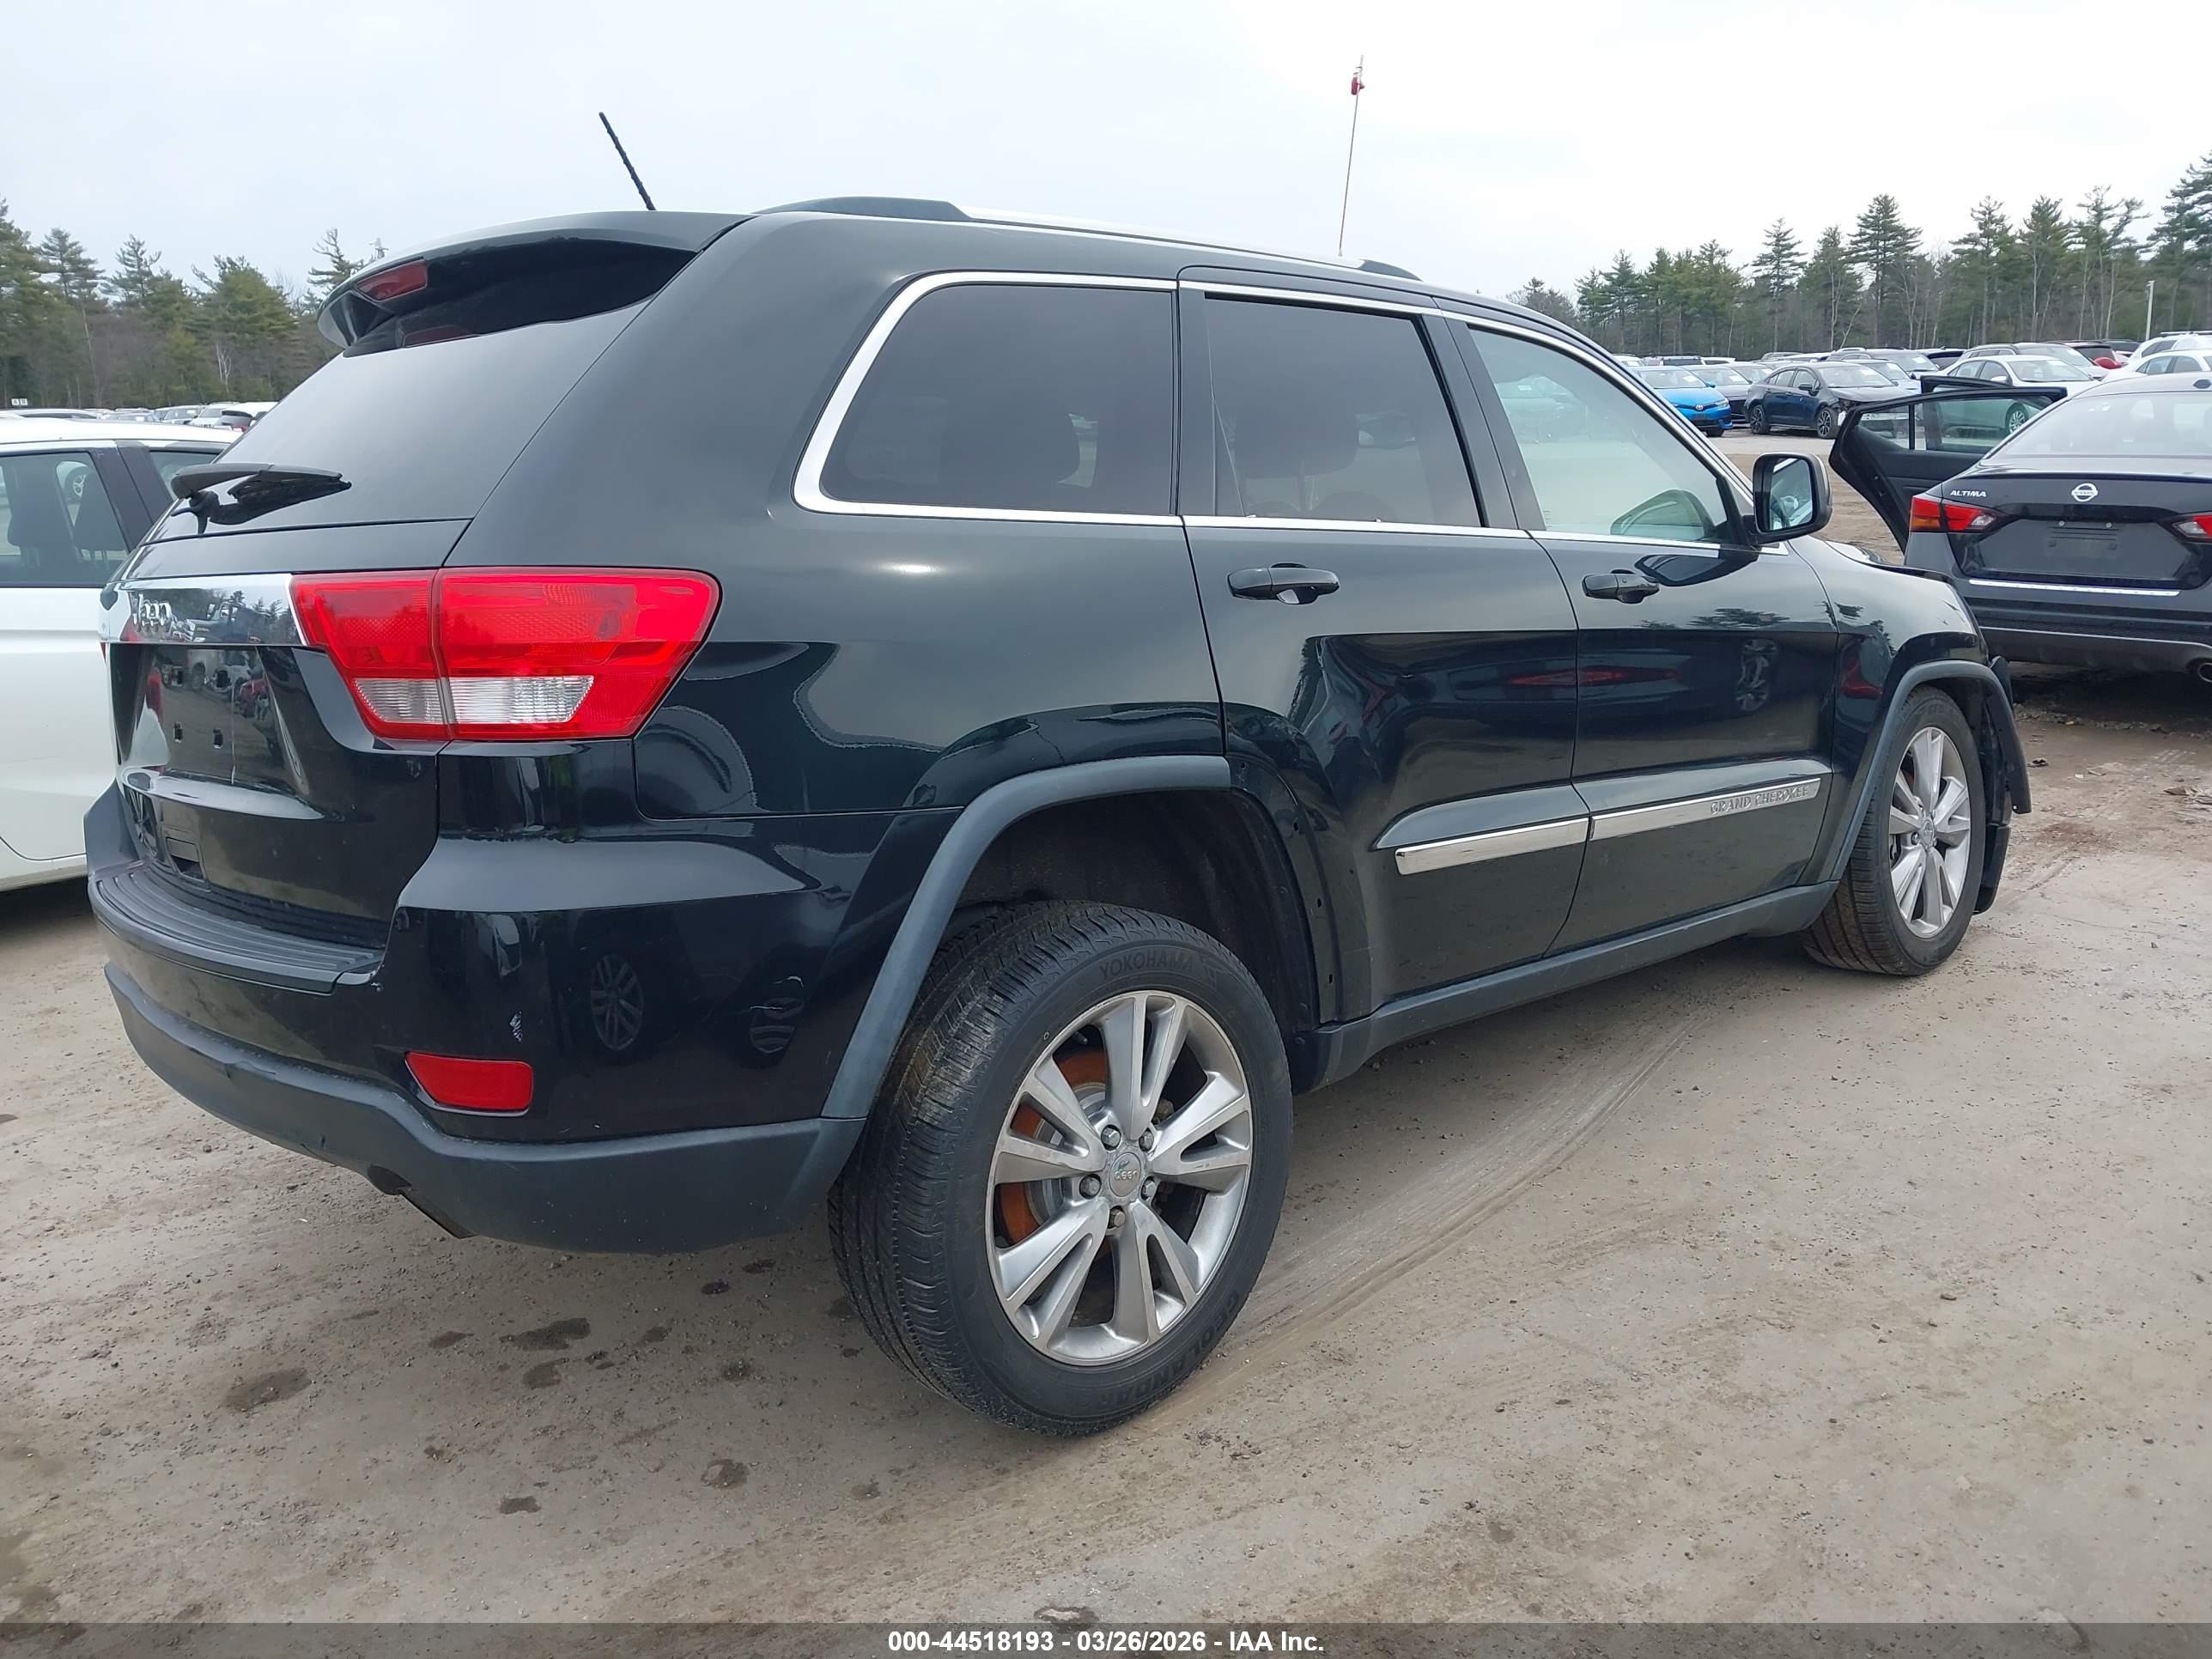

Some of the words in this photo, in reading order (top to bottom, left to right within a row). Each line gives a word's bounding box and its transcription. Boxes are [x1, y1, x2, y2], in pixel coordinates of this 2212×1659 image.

[1710, 796, 1752, 815] GRAND
[1754, 785, 1810, 806] CHEROKEE
[1099, 948, 1194, 980] YOKOHAMA
